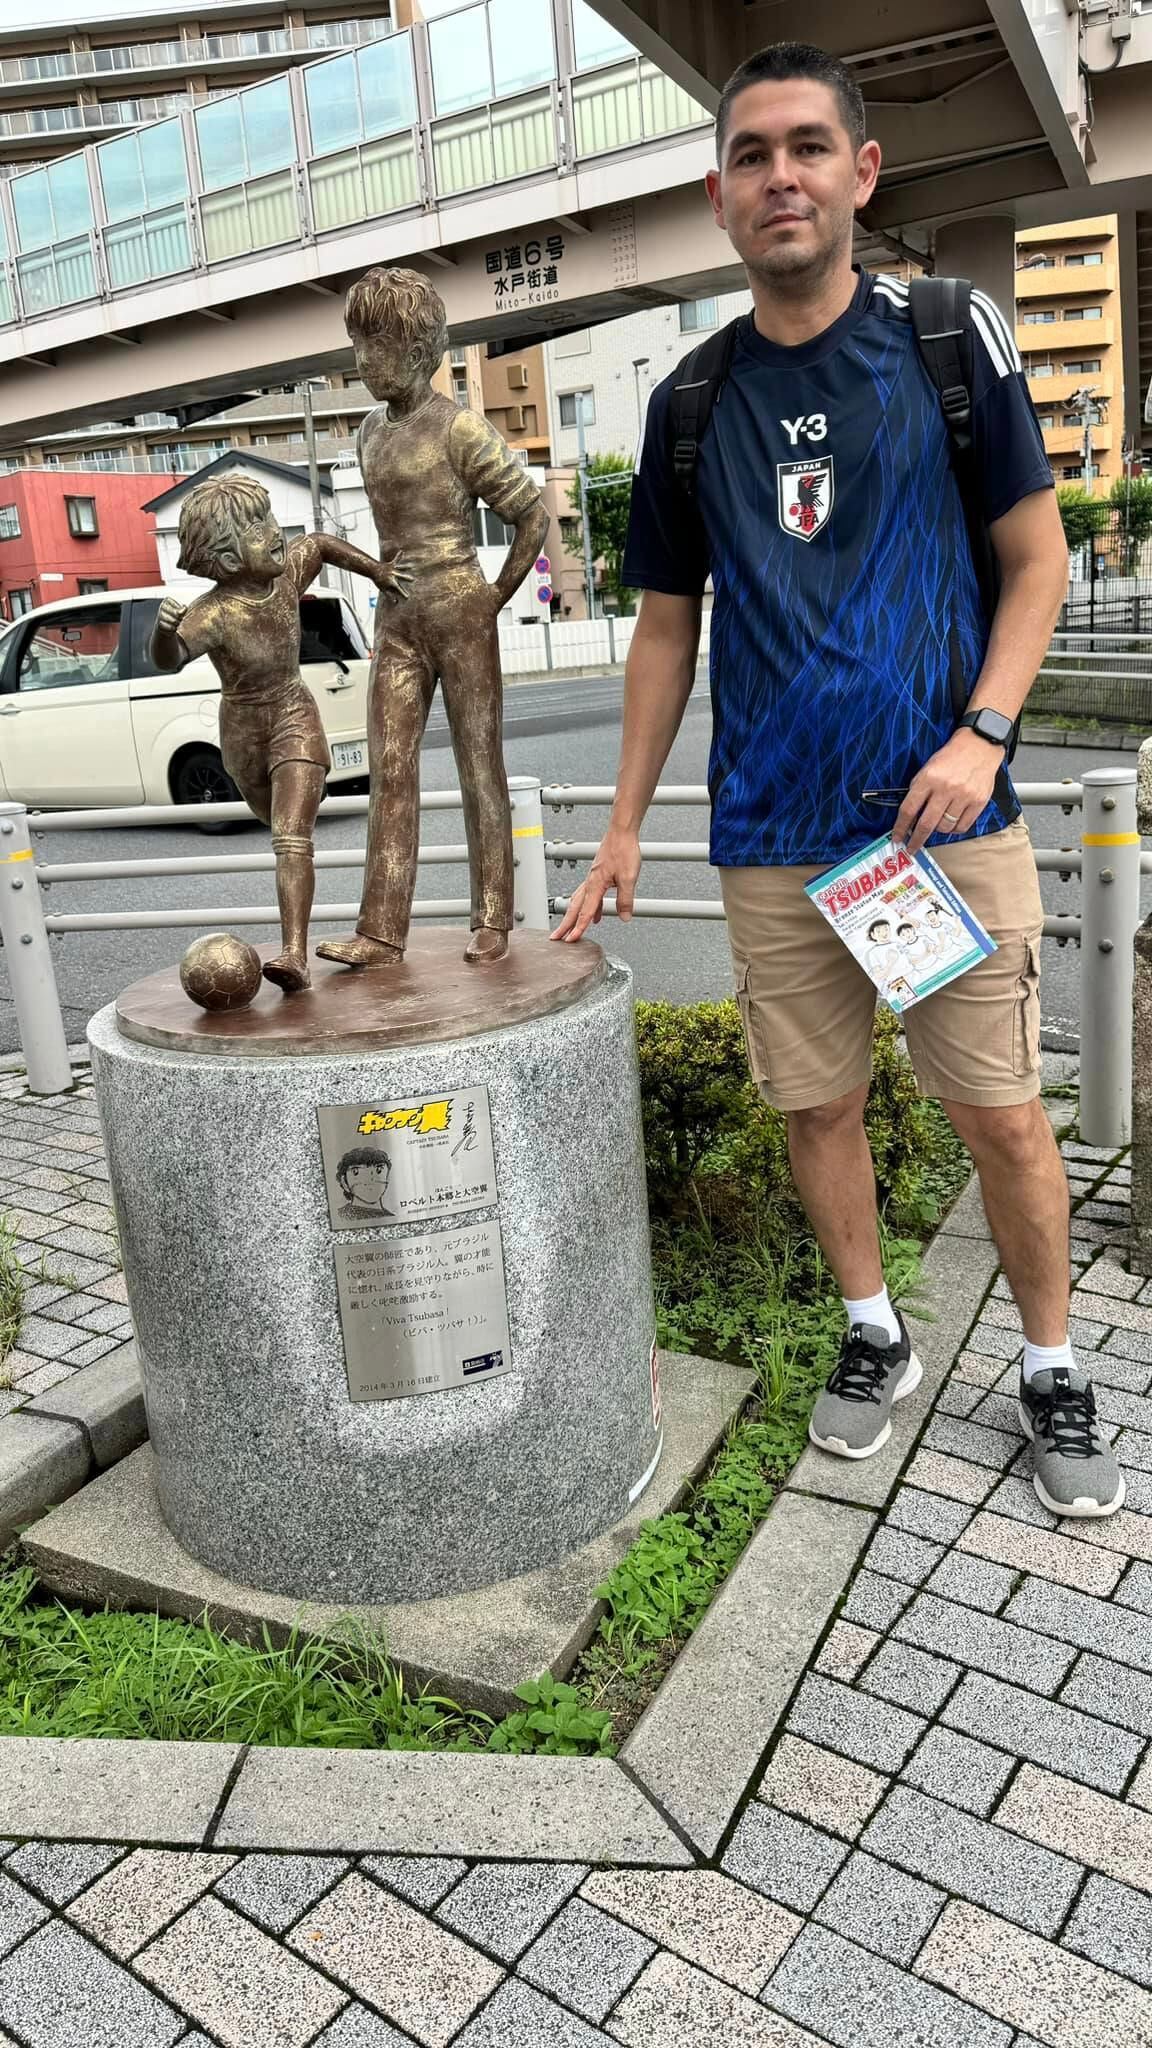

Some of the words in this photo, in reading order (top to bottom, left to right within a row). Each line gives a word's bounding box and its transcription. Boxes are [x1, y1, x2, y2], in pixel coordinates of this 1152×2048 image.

[486, 235, 565, 274] 国道6号
[494, 264, 558, 296] 水戸街道
[495, 289, 559, 311] Mito-Kaido
[780, 413, 828, 445] Y-3
[791, 462, 821, 473] JAPAN
[796, 512, 820, 528] JFA
[825, 847, 914, 918] TSUBASA
[833, 907, 854, 924] Bronze
[853, 895, 873, 912] Statue
[870, 888, 884, 900] Map
